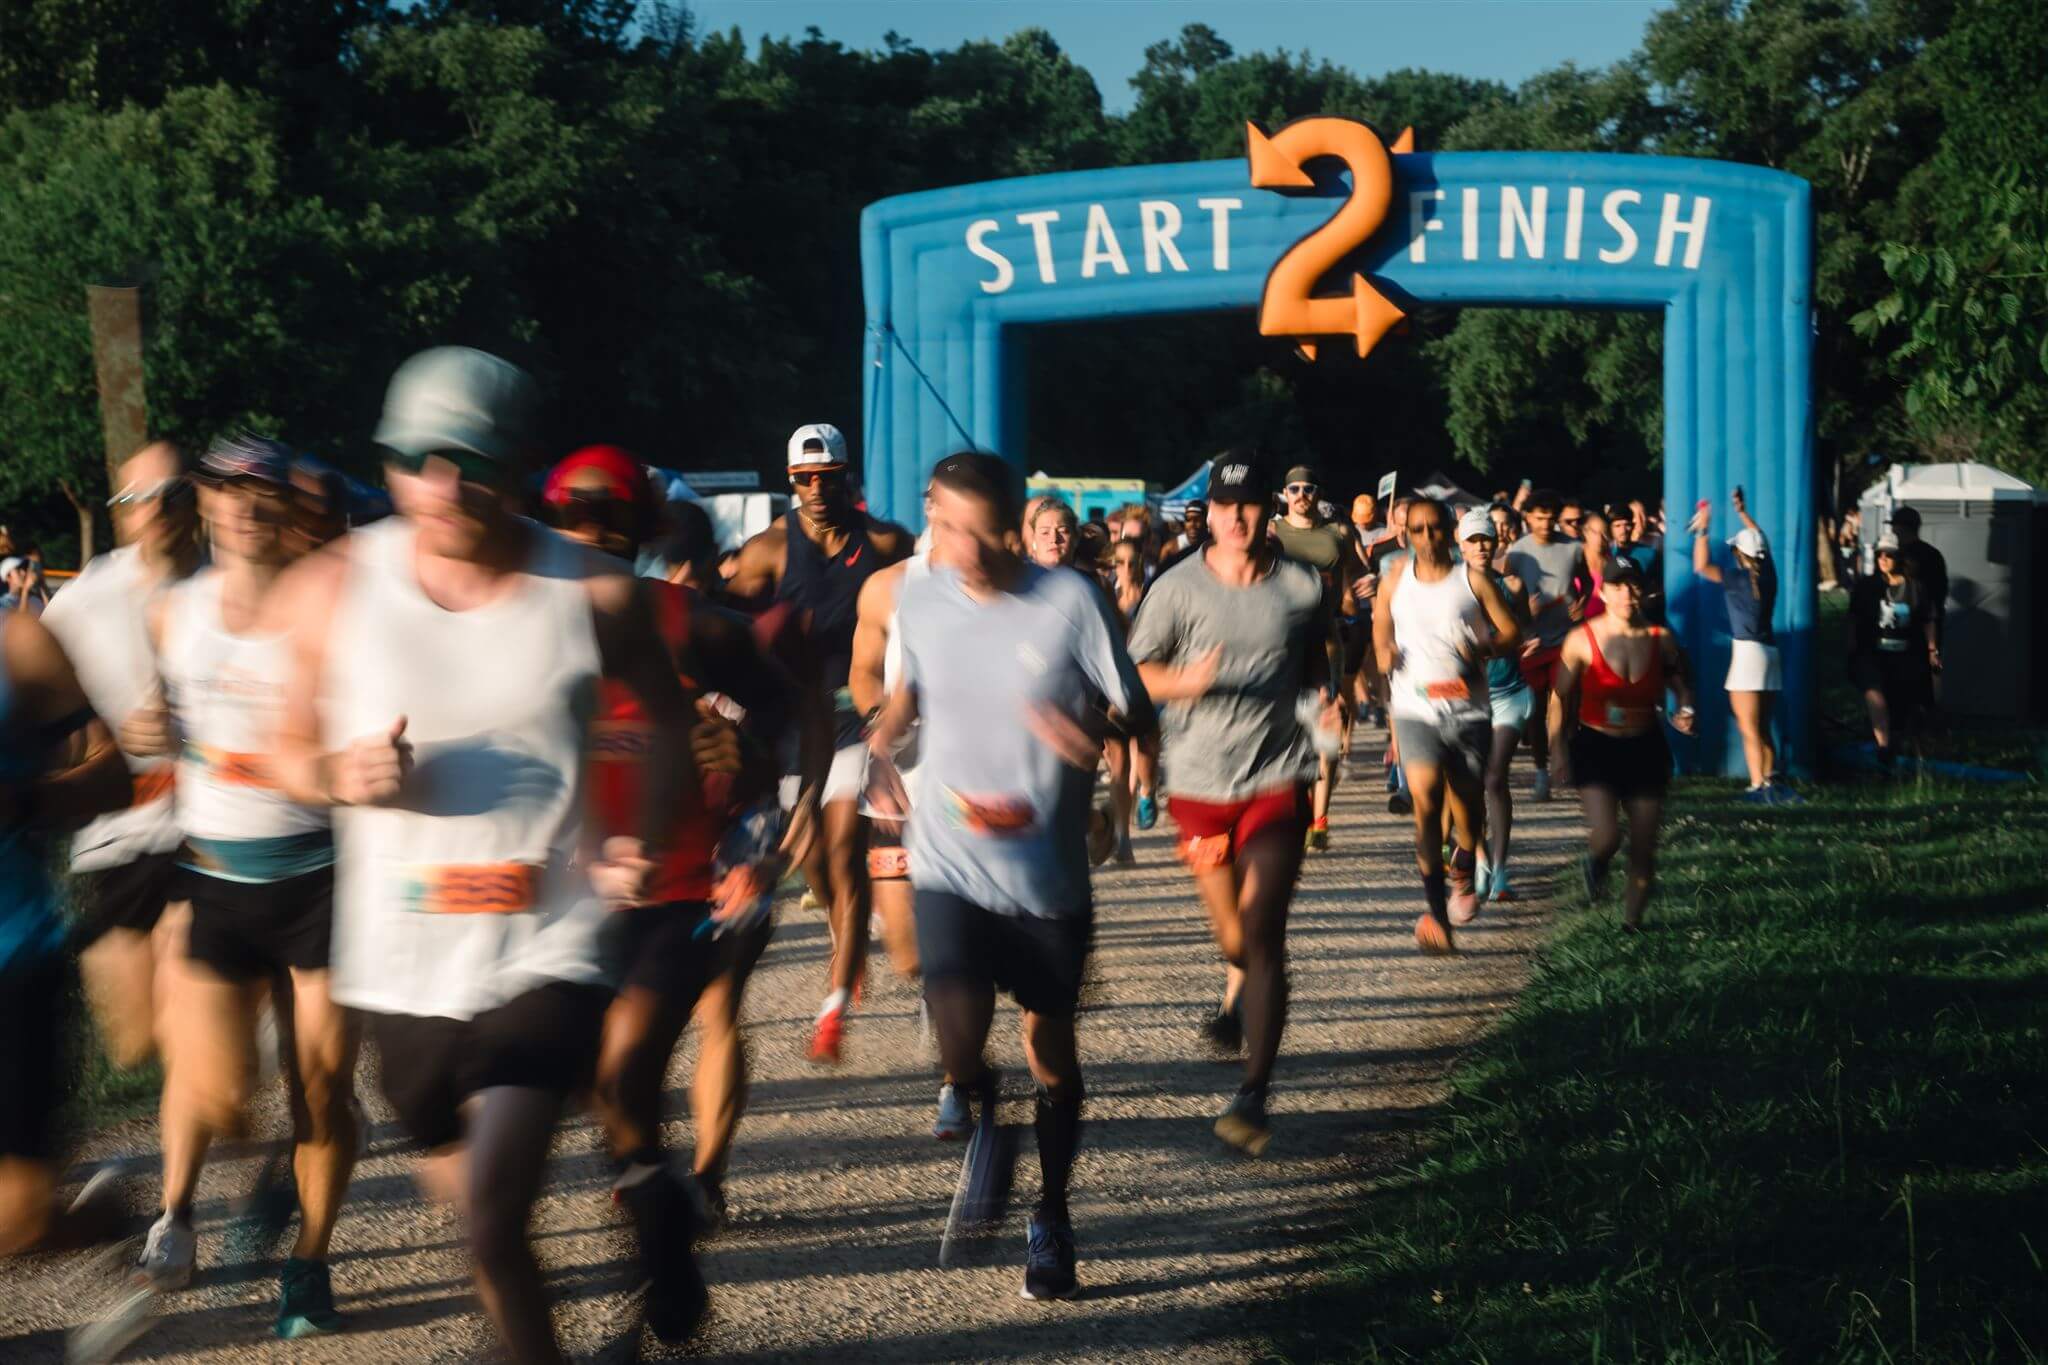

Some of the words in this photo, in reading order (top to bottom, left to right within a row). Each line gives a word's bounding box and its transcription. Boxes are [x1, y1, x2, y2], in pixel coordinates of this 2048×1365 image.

[965, 197, 1243, 294] START
[1246, 116, 1407, 359] 2
[1409, 186, 1712, 271] FINISH
